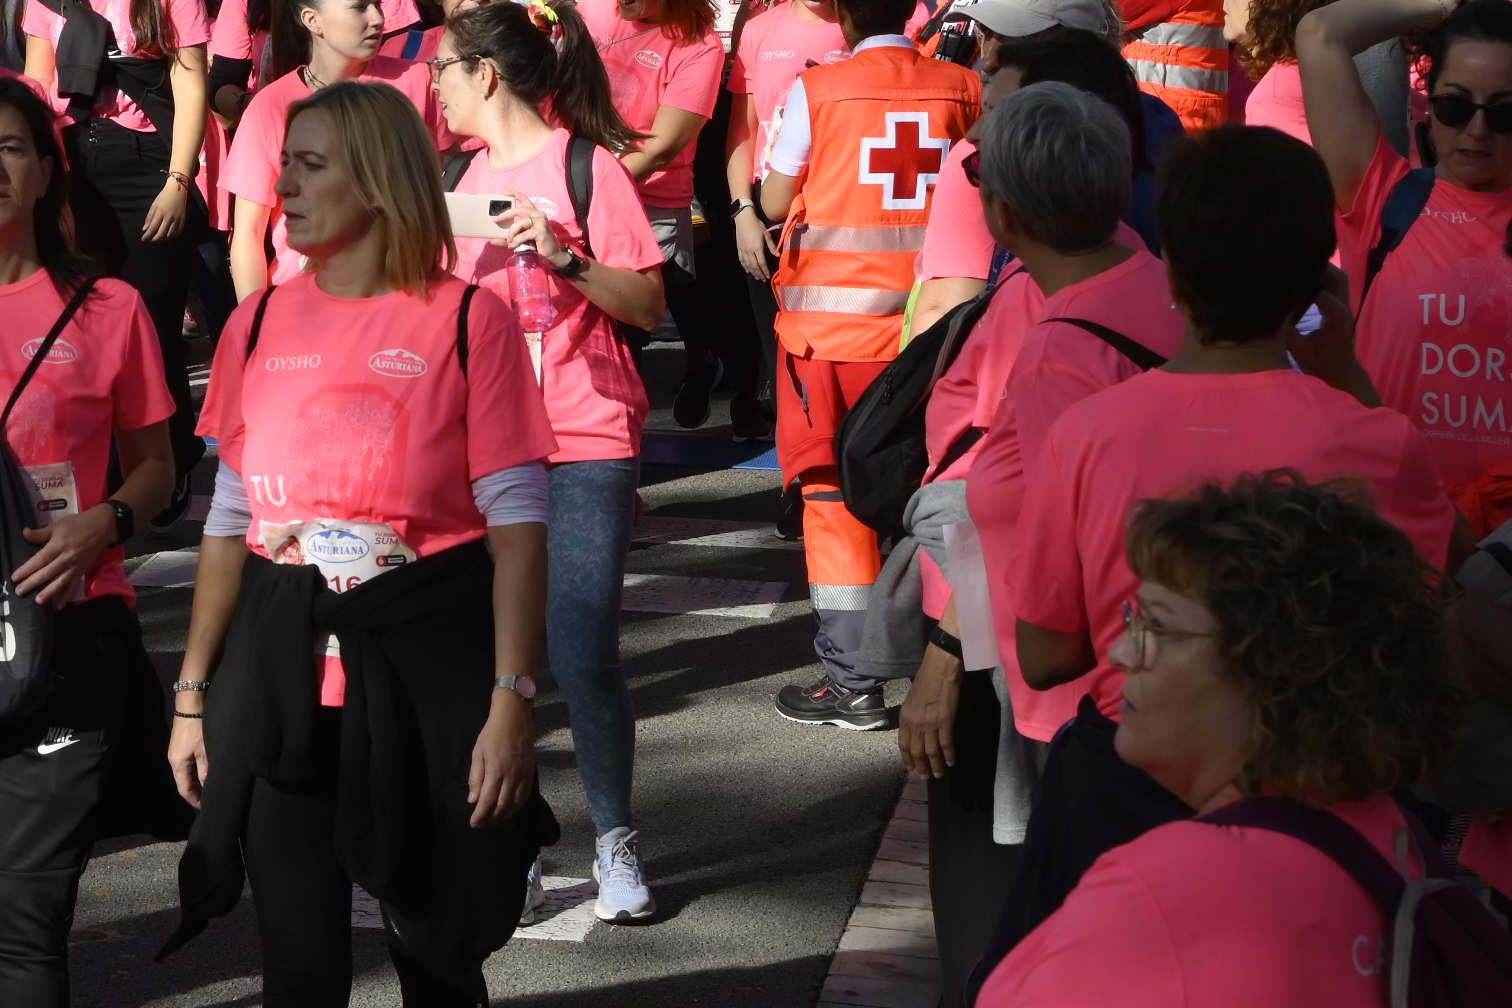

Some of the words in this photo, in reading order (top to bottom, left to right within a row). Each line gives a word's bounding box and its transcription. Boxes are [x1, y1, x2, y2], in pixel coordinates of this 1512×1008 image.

[1418, 293, 1466, 327] TU
[265, 354, 322, 372] OYSHO
[373, 356, 424, 374] ASTURIANA
[1420, 342, 1512, 382] DOR
[1421, 391, 1512, 433] SUM
[250, 474, 287, 508] TU
[309, 542, 365, 556] ASTURIANA
[46, 727, 75, 743] NIKE
